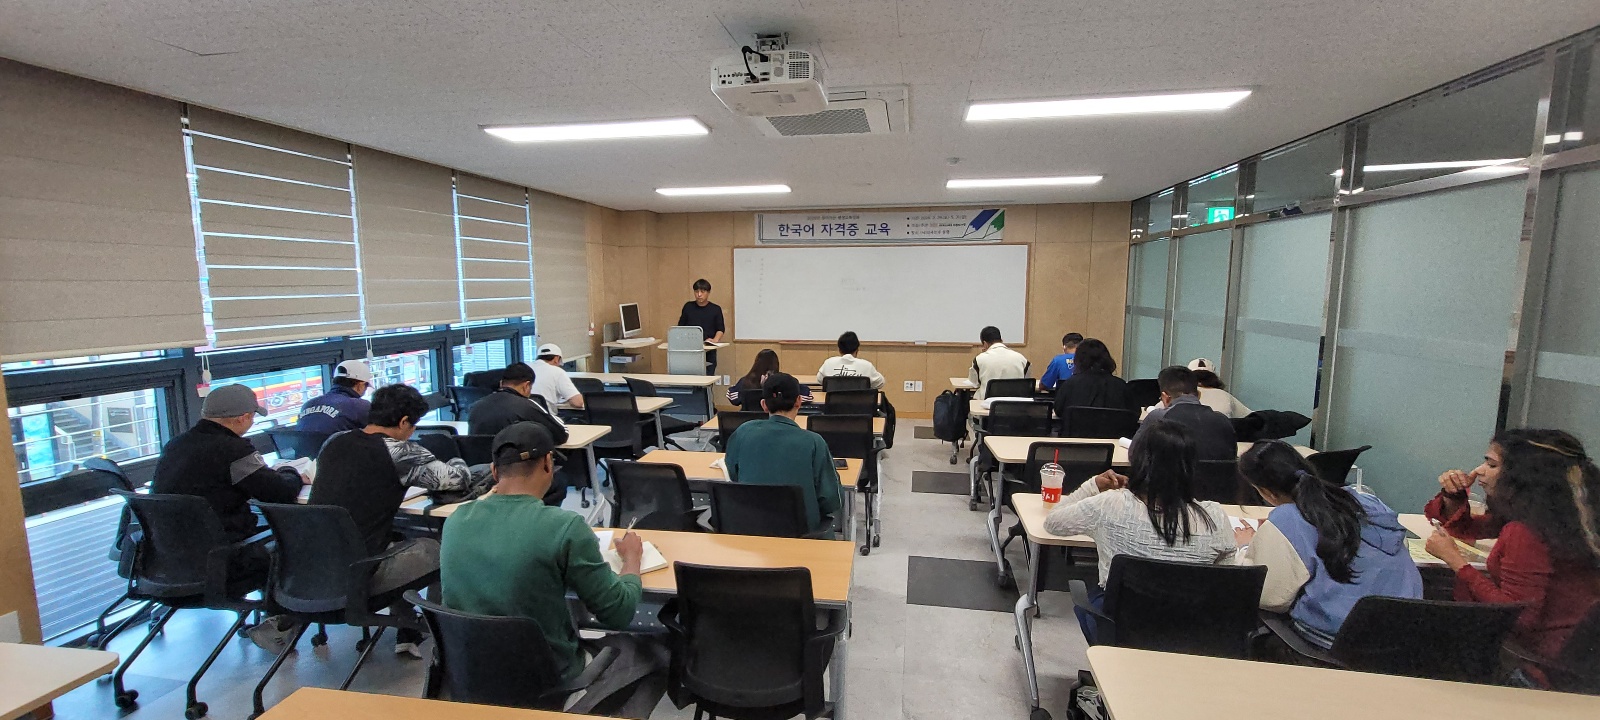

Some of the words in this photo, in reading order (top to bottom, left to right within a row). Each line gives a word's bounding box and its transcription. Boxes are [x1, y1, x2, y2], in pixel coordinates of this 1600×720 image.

[778, 223, 814, 237] 한국어
[820, 223, 859, 237] 자격증
[864, 222, 891, 236] 교육
